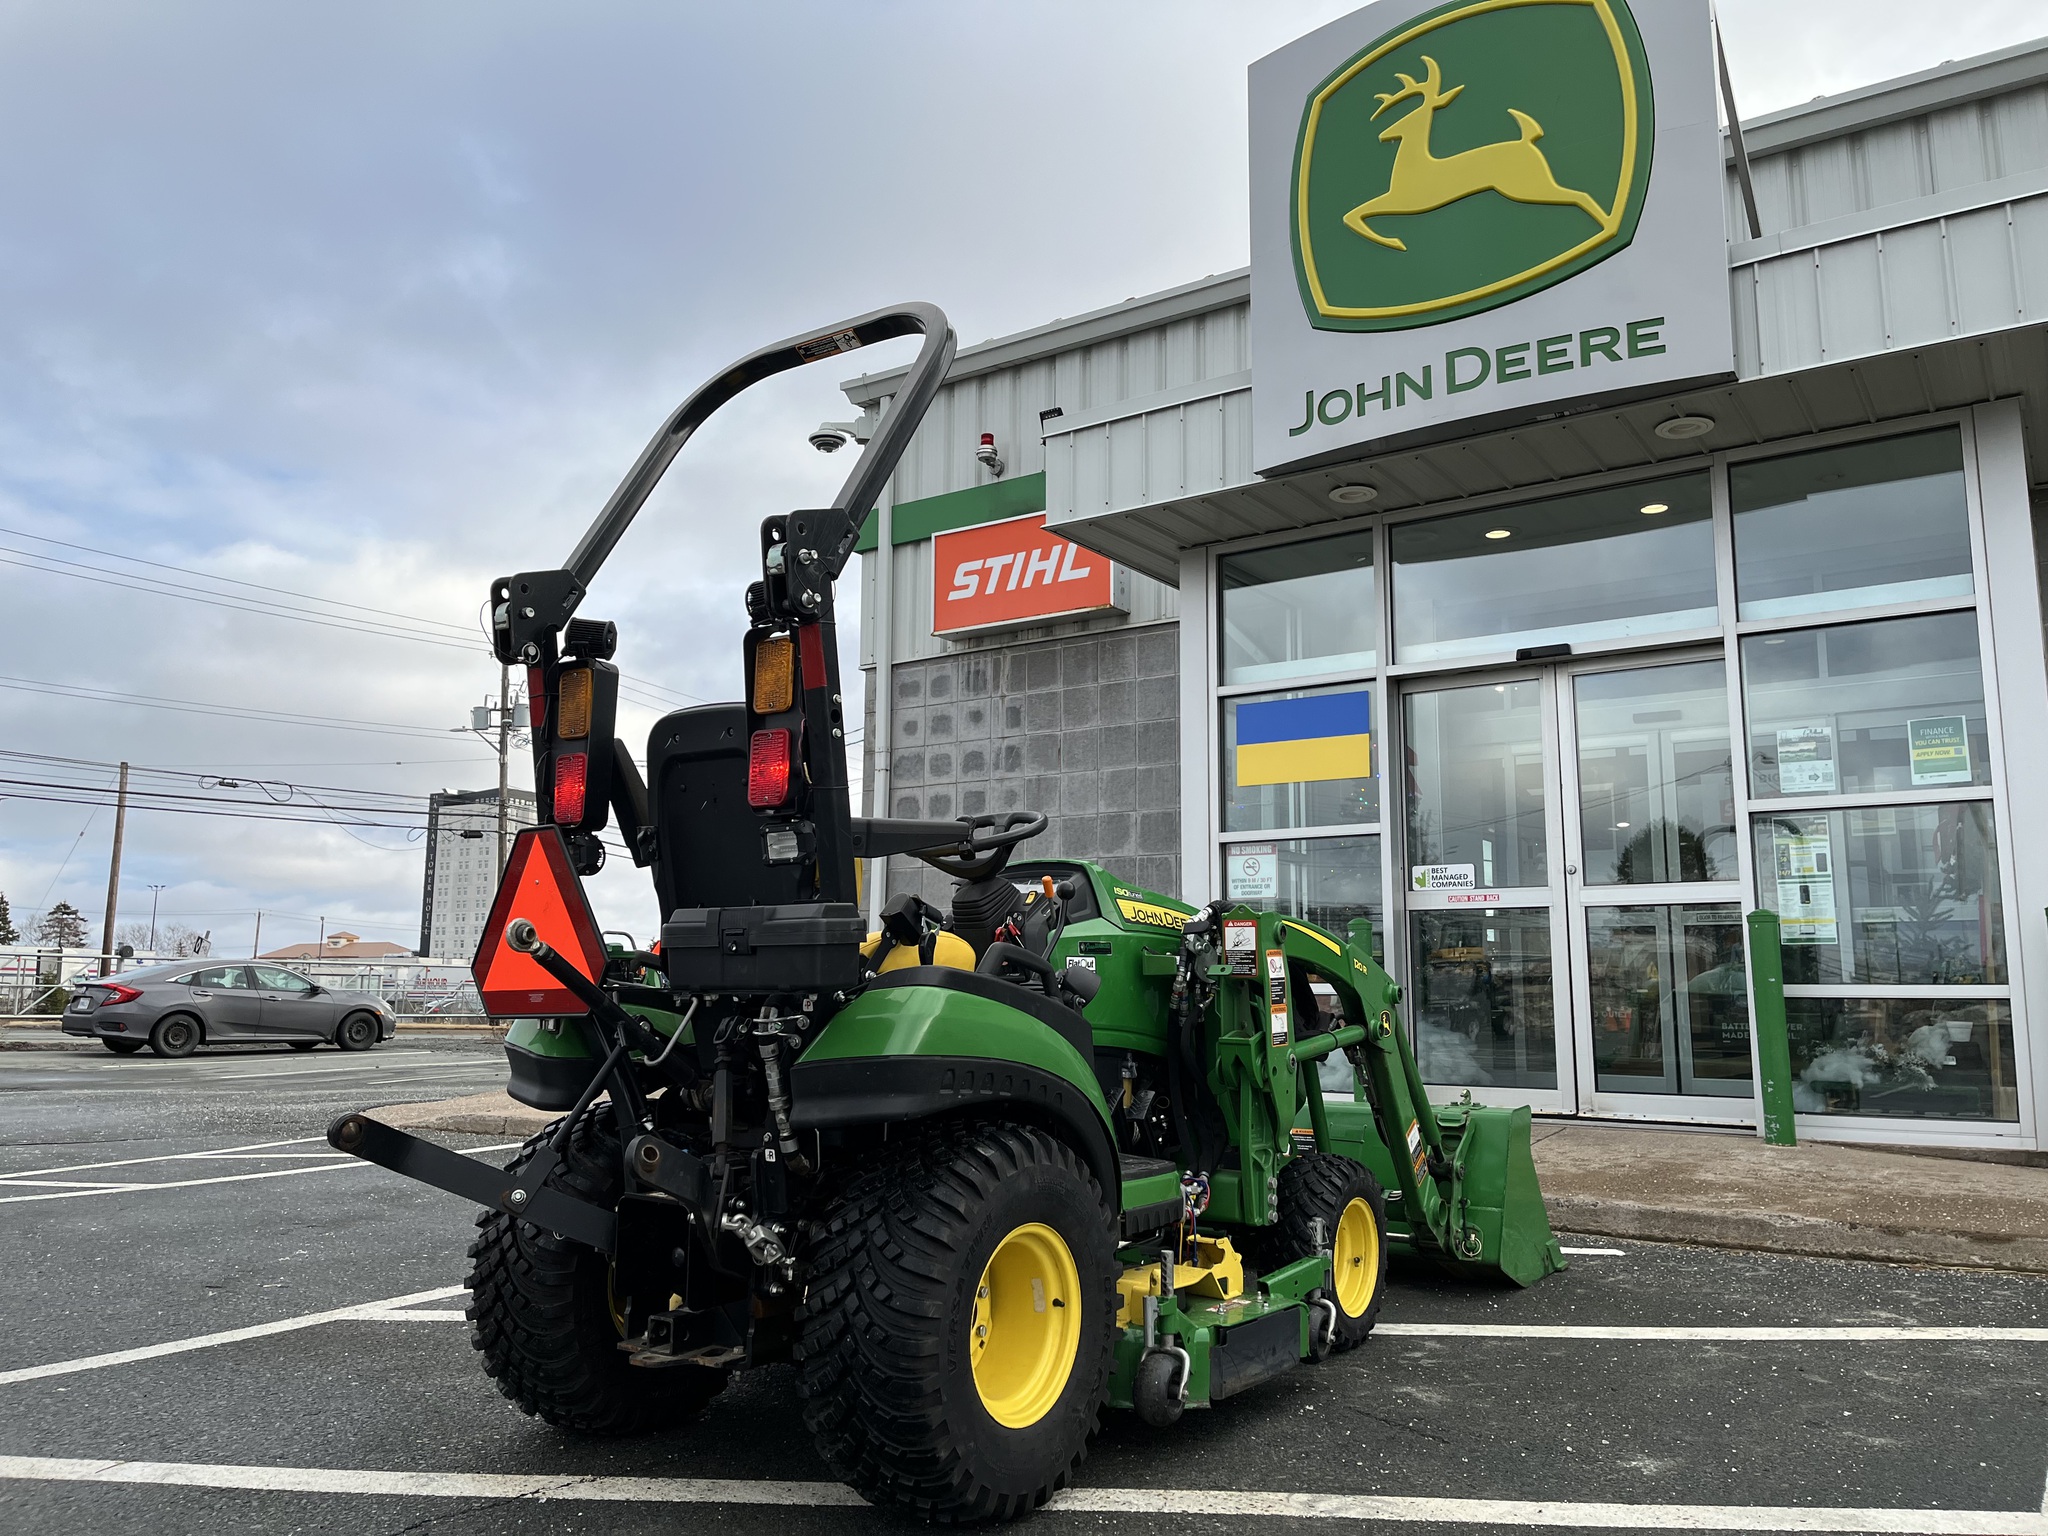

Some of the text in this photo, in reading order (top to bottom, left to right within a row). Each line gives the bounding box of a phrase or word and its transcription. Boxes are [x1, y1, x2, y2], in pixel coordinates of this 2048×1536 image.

[1289, 316, 1667, 437] JOHN DEERE
[946, 542, 1091, 602] STIHL
[1920, 726, 1954, 736] FINANCE
[1231, 845, 1272, 855] NO SMOKING
[1431, 873, 1469, 881] MANAGED
[1431, 880, 1474, 889] COMPANIES
[1448, 895, 1468, 903] CAUTION
[424, 897, 432, 935] HOTEL
[1130, 906, 1187, 928] JOHN DEE
[1721, 1022, 1750, 1031] BATT
[1722, 1031, 1750, 1039] MADE
